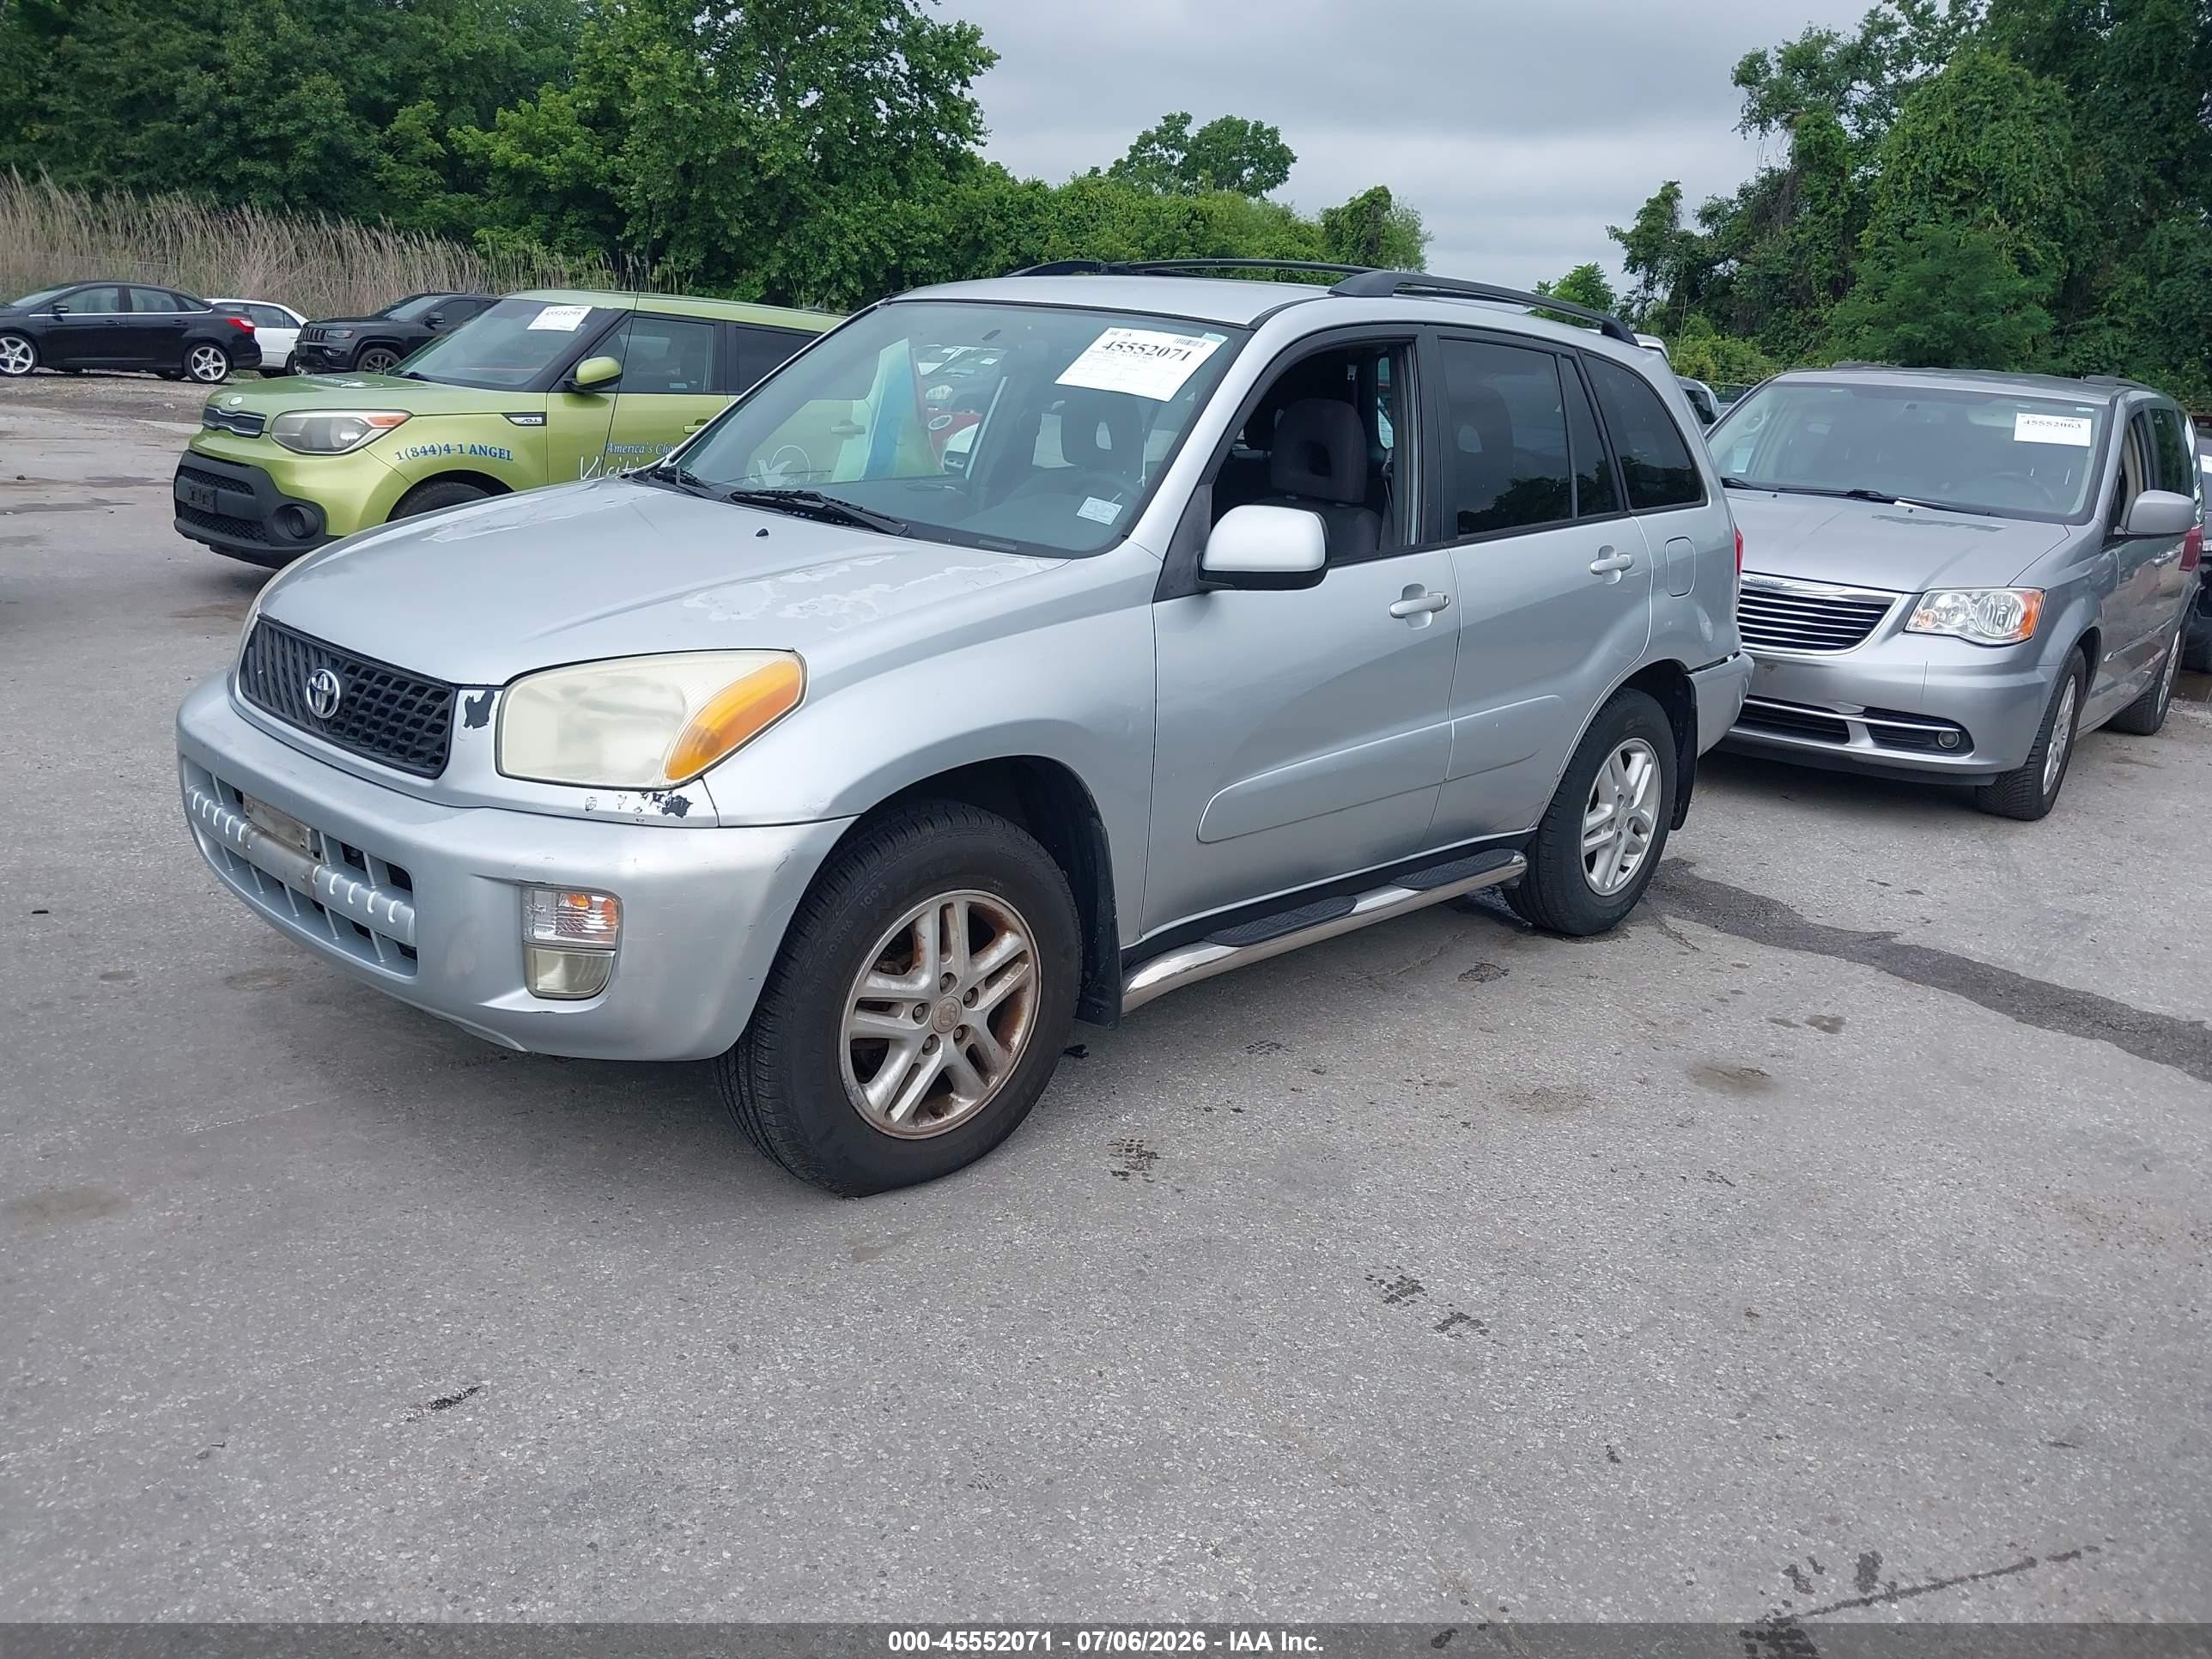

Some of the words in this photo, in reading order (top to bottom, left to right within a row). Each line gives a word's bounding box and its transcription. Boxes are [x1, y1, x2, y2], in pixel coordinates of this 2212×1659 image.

[1102, 341, 1192, 362] 45552071
[394, 442, 465, 461] 1(844)4-1
[469, 443, 514, 461] ANGEL
[606, 440, 653, 454] America's
